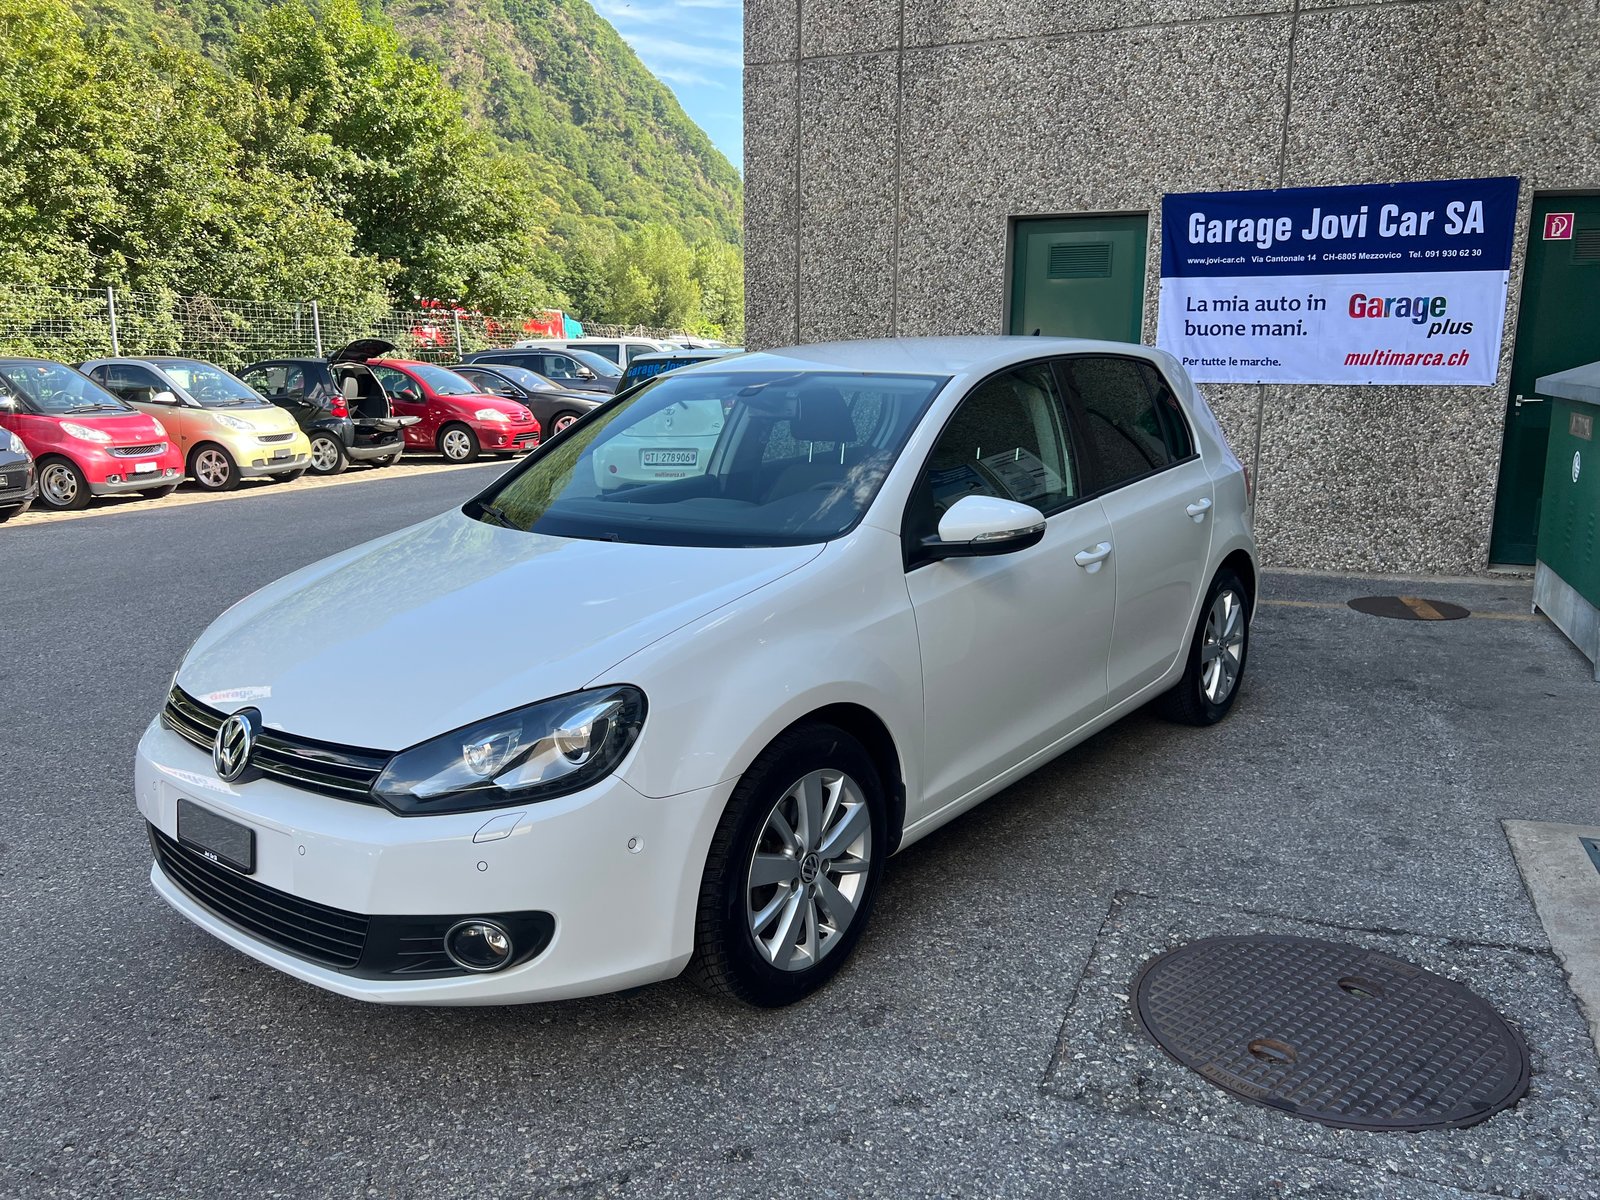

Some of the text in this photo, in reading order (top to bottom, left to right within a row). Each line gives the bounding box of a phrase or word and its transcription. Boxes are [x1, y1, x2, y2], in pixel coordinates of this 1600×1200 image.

[1188, 200, 1484, 250] Garage Jovi Car SA
[1187, 256, 1245, 266] www.jovi-car.ch
[1251, 255, 1265, 263] Via
[1265, 254, 1305, 263] Cantonale
[1322, 253, 1357, 261] CH-6805
[1358, 252, 1402, 260] Mezzovico
[1408, 250, 1423, 258] Tel.
[1425, 250, 1440, 258] 091
[1442, 249, 1457, 257] 930
[1459, 249, 1469, 257] 62
[1471, 248, 1482, 257] 30
[1186, 294, 1326, 312] La mia auto in
[1348, 293, 1447, 325] Garage
[1184, 319, 1308, 336] buone mani.
[1426, 318, 1474, 339] plus
[1182, 356, 1281, 367] Per tutte le marche.
[1344, 349, 1470, 366] multimarca.ch
